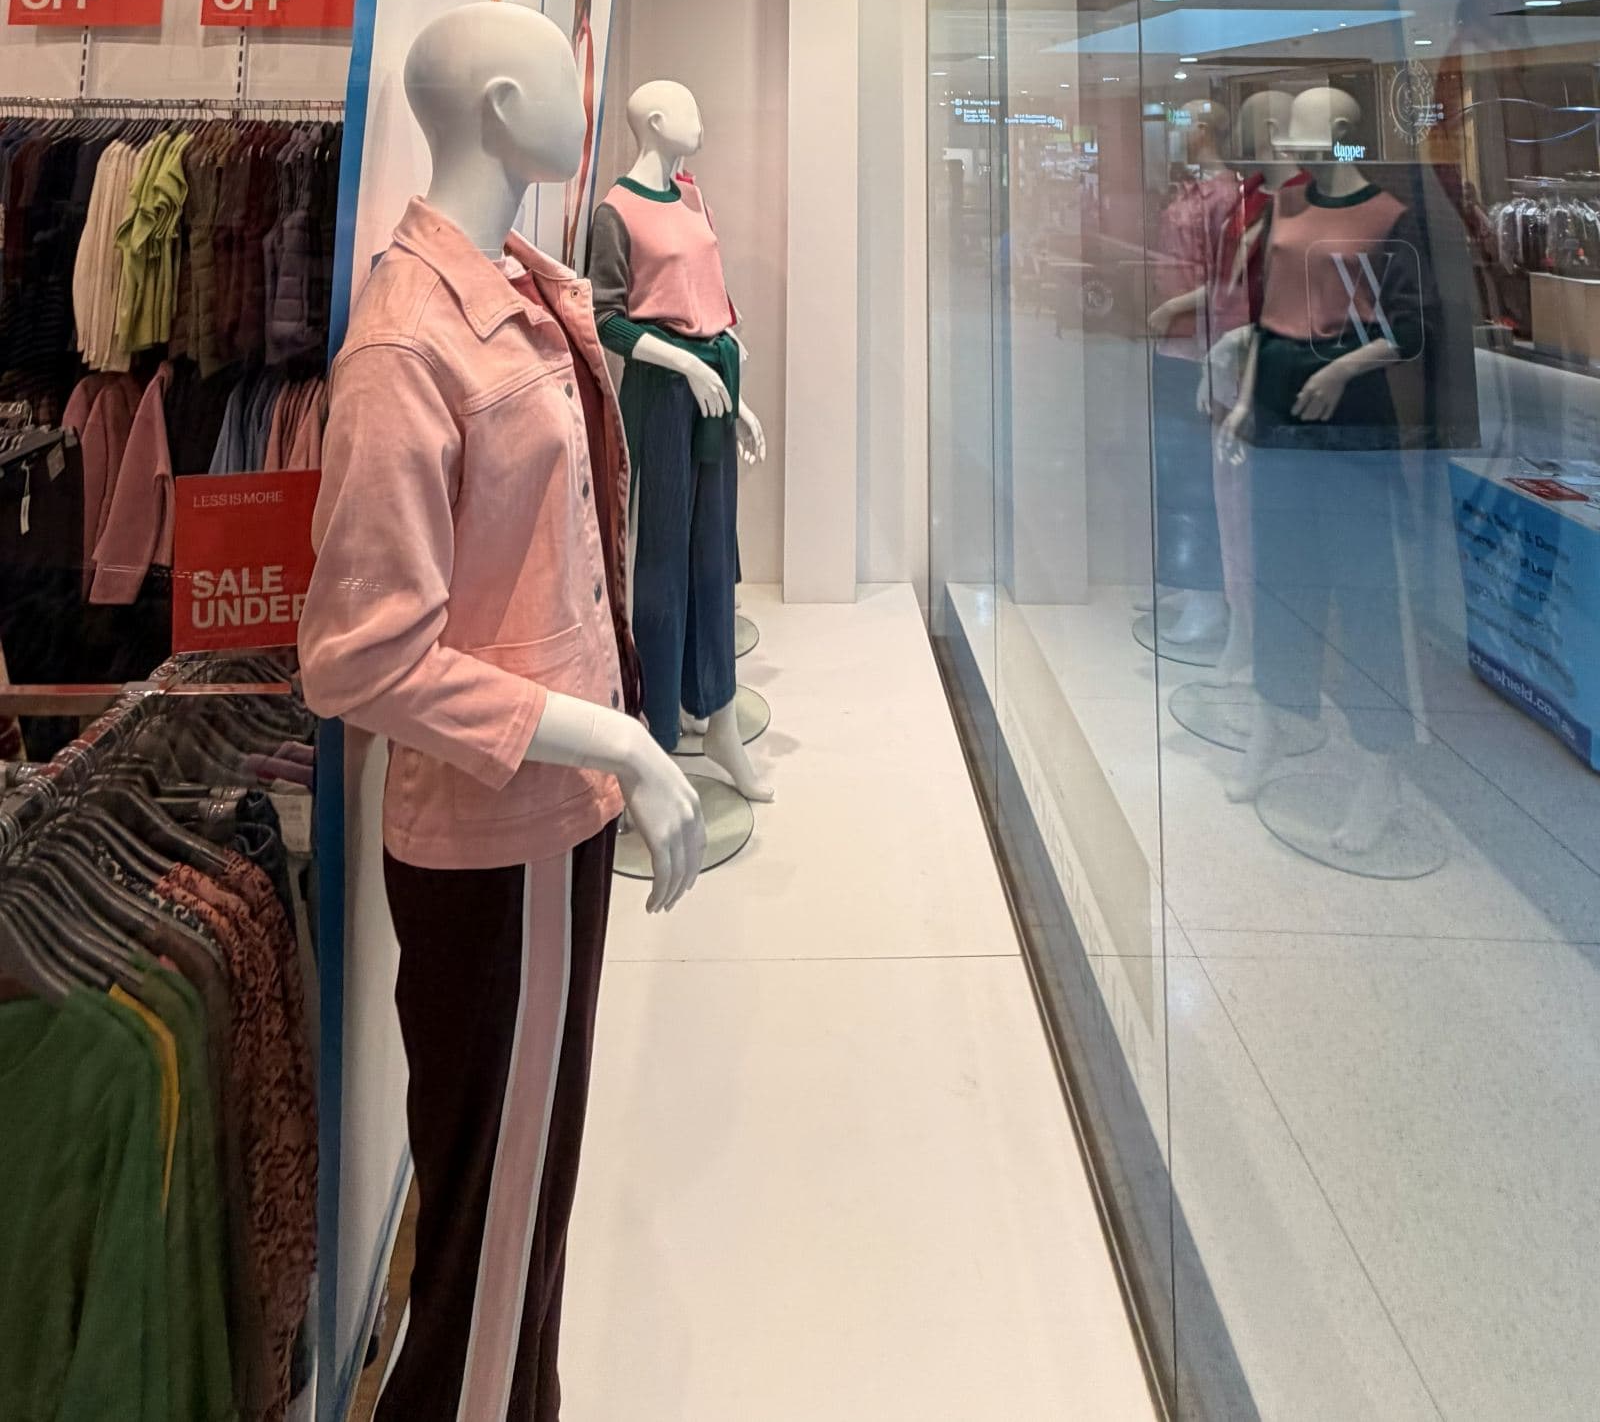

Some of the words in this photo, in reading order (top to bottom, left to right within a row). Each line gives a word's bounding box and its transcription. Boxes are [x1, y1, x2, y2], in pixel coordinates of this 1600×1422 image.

[1334, 141, 1365, 161] dapper
[193, 494, 227, 508] LESS
[229, 493, 242, 506] IS
[243, 490, 285, 505] MORE
[192, 566, 284, 599] SALE
